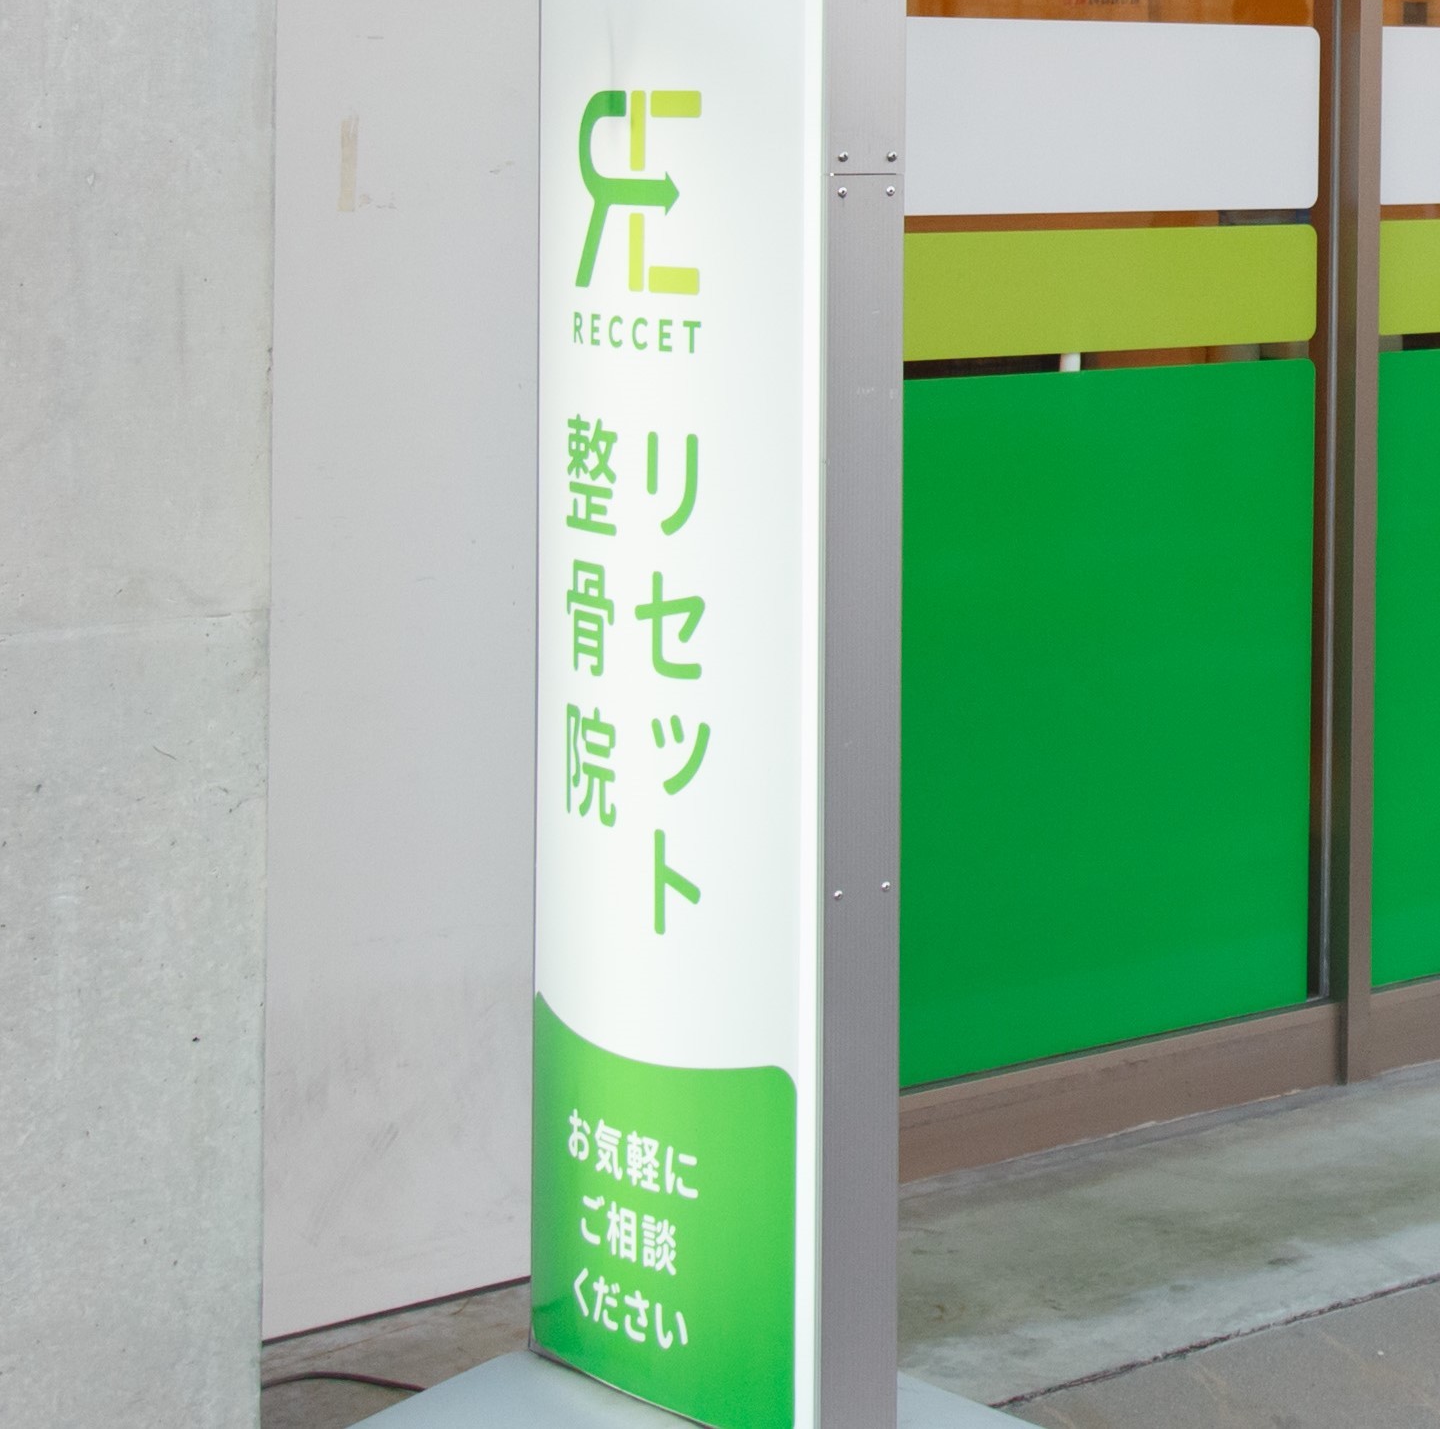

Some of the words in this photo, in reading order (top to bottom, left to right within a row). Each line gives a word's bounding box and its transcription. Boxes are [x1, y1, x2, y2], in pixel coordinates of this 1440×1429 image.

[572, 311, 702, 355] RECCET
[565, 412, 619, 829] 整骨院
[634, 430, 712, 936] リセット
[567, 1108, 699, 1199] お気軽に
[580, 1194, 677, 1276] ご相談
[573, 1267, 689, 1350] ください
